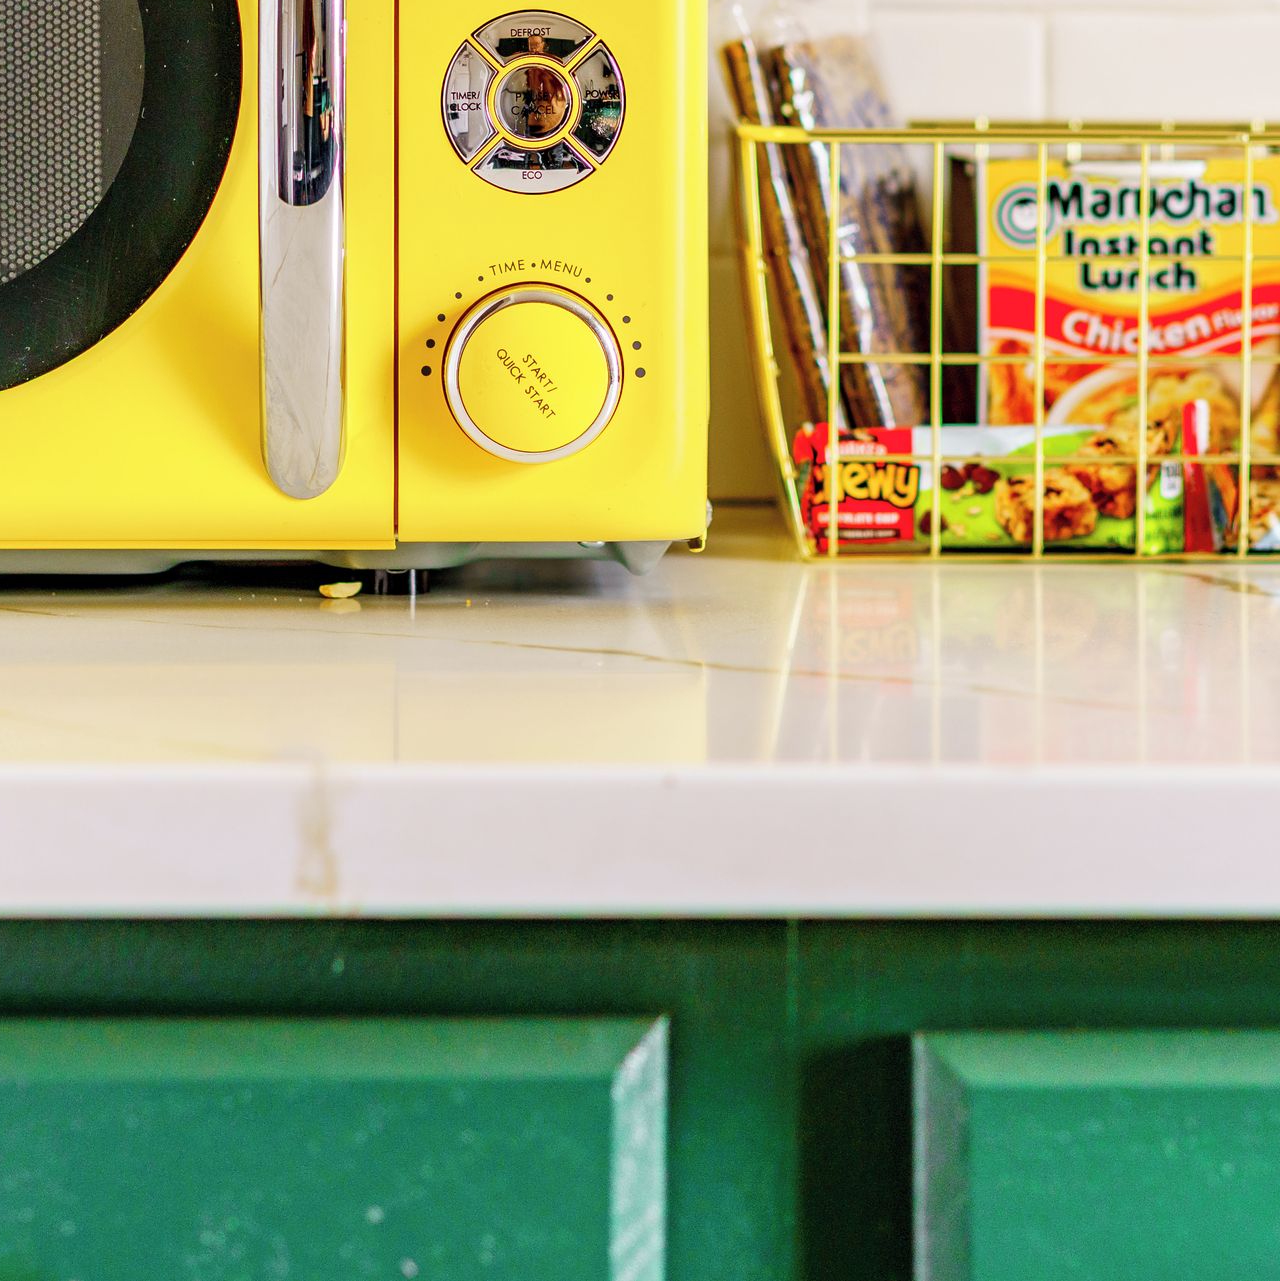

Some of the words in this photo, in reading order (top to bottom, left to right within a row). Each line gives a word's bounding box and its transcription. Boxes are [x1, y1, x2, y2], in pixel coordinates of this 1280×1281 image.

[510, 26, 552, 38] DEFROST
[451, 90, 481, 101] TIMER/
[450, 102, 482, 113] CLOCK
[521, 170, 543, 181] ECO
[1046, 180, 1267, 220] Maruchan
[1064, 230, 1213, 257] Instant
[488, 259, 526, 277] TIME
[539, 259, 584, 278] MENU
[1079, 262, 1198, 292] Lunch
[496, 348, 527, 385] QUICK
[524, 385, 557, 420] START
[522, 353, 558, 393] START/
